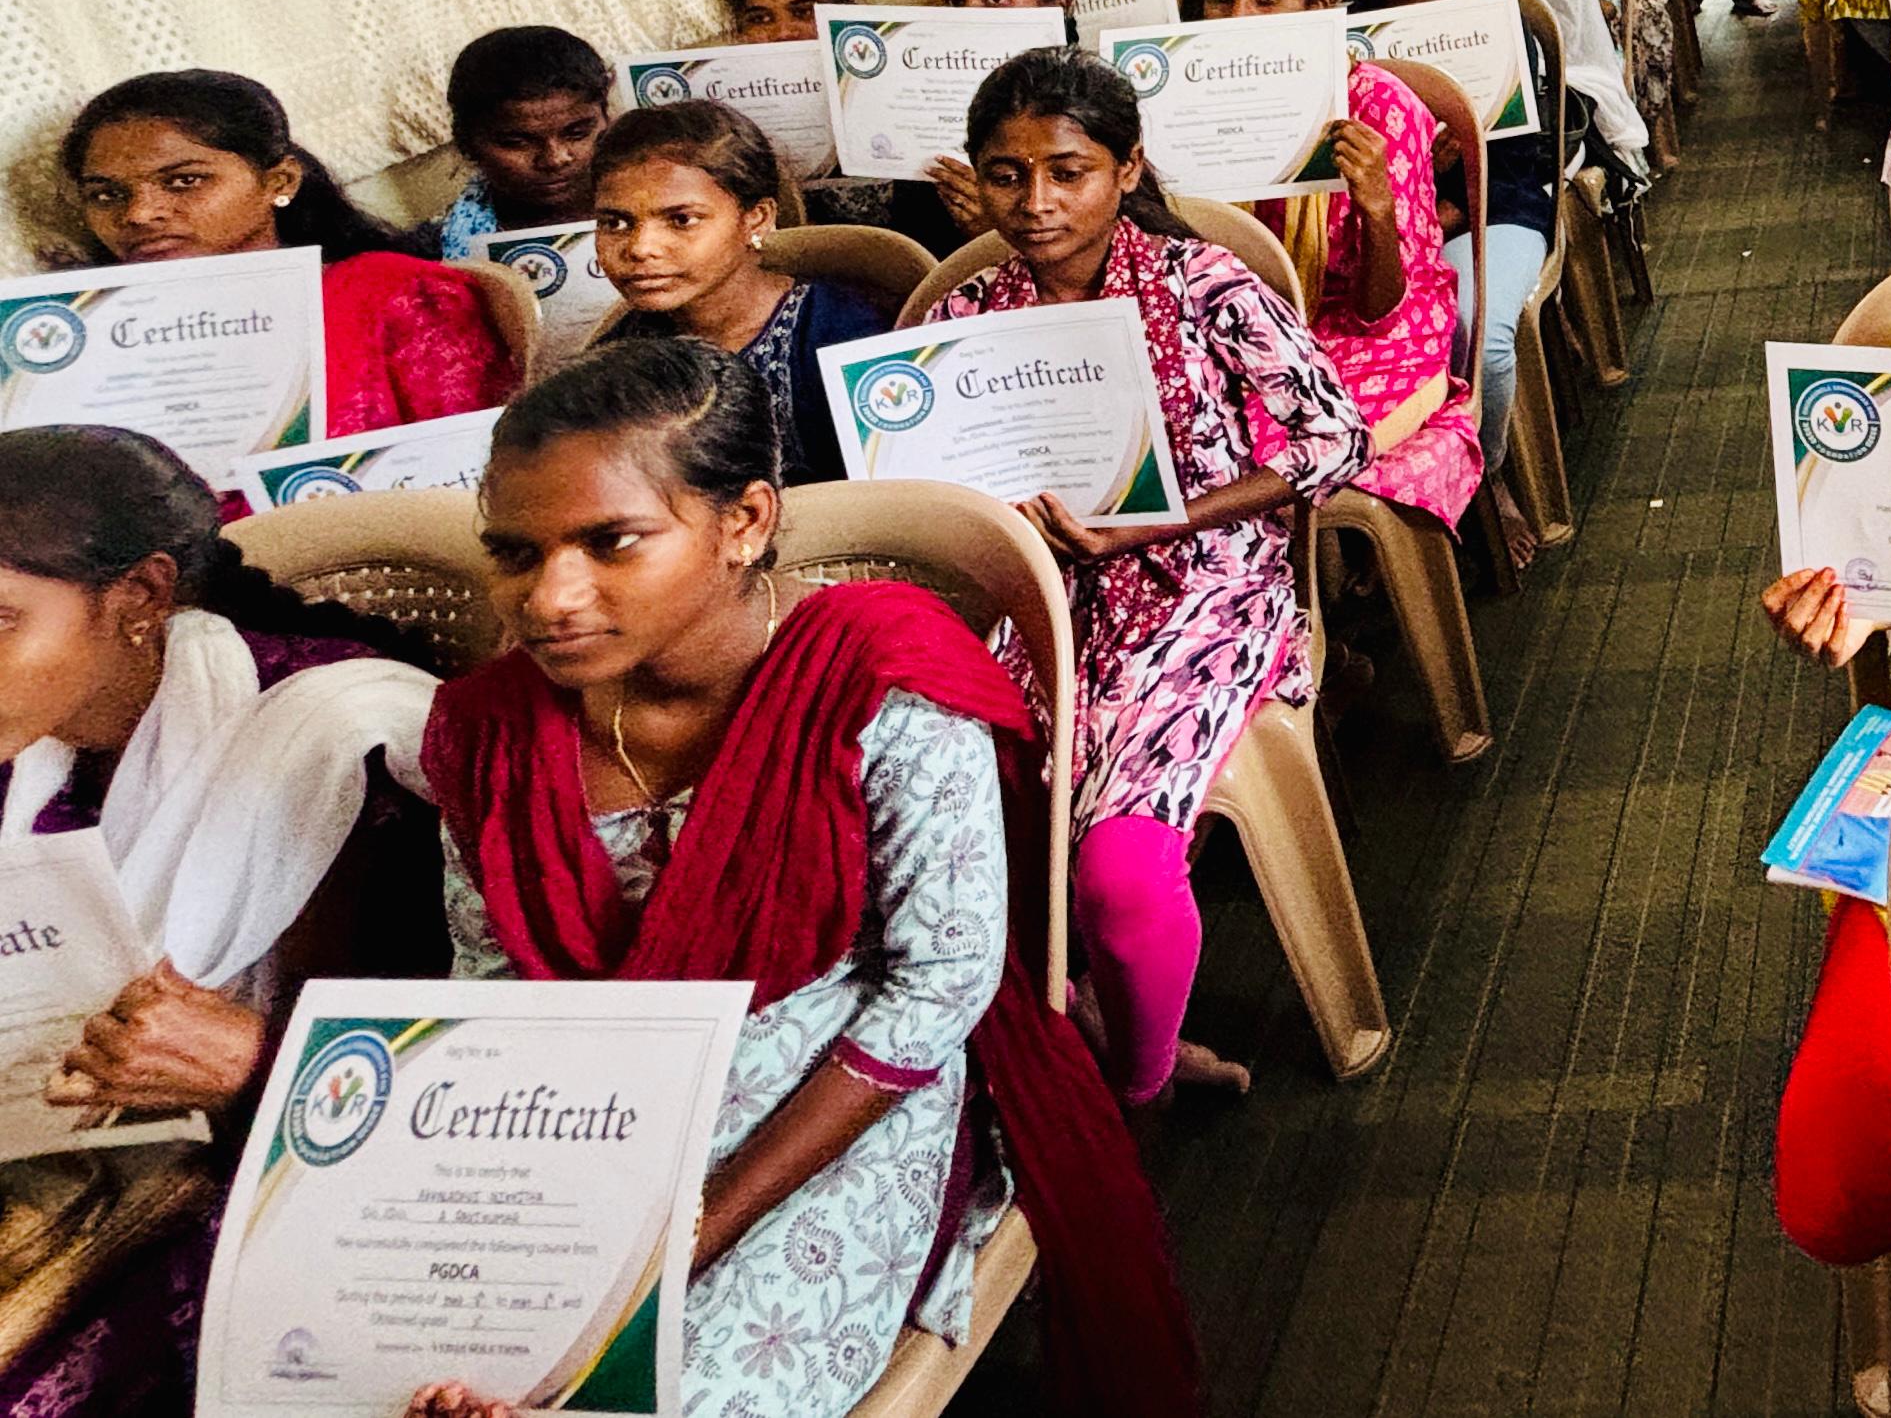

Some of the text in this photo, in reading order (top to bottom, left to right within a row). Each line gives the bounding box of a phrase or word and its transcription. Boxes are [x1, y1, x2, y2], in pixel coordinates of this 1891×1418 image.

[1388, 30, 1489, 60] Certificate
[1185, 54, 1306, 83] Certificate
[705, 78, 822, 101] Certificate
[111, 309, 274, 348] Certificate
[956, 358, 1106, 399] Certificate
[1018, 446, 1051, 458] PGDCA
[410, 1081, 637, 1142] Certificate
[429, 1263, 479, 1280] PGDCA
